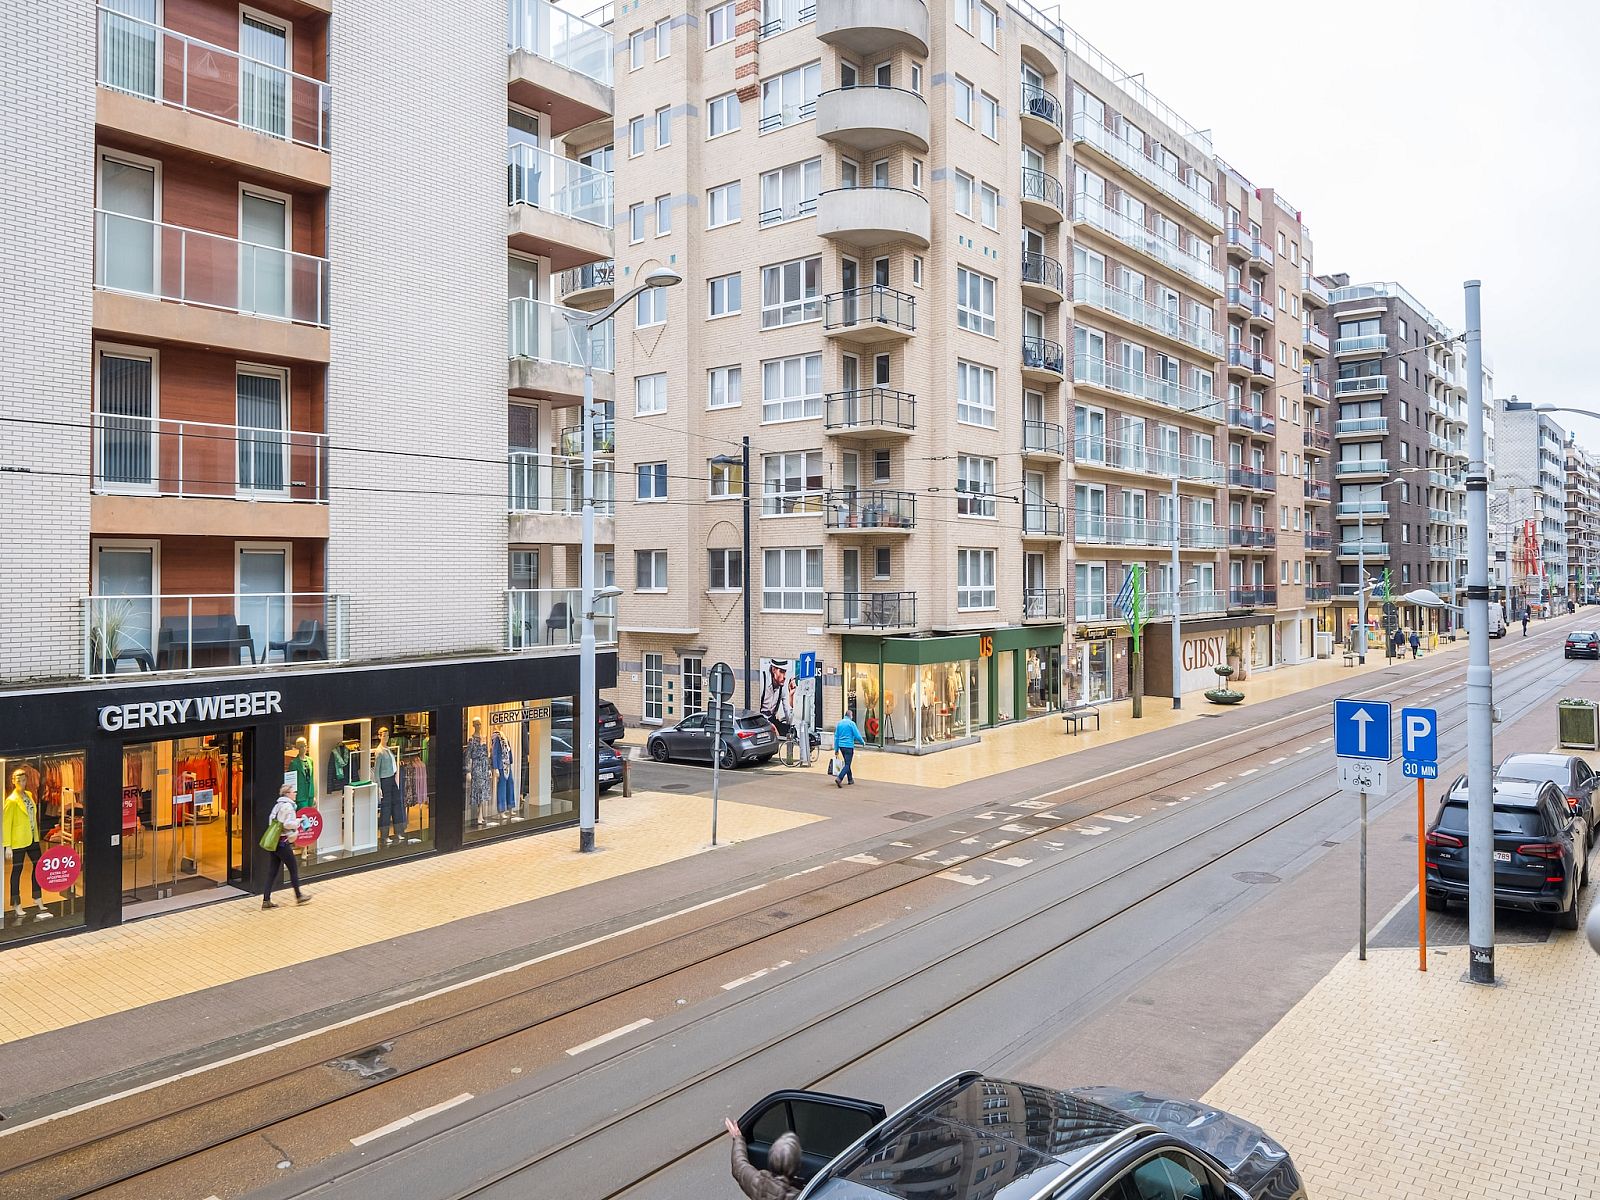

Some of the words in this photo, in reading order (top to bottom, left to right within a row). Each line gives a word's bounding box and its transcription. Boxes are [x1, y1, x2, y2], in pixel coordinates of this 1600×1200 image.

[1182, 636, 1224, 671] GIBSY
[99, 699, 191, 732] GERRY
[194, 691, 283, 721] WEBER
[492, 711, 520, 724] GERRY
[521, 707, 549, 719] WEBER
[1406, 715, 1431, 752] P
[1404, 763, 1418, 775] 30
[1421, 765, 1436, 776] MIN
[184, 777, 217, 790] WEBER
